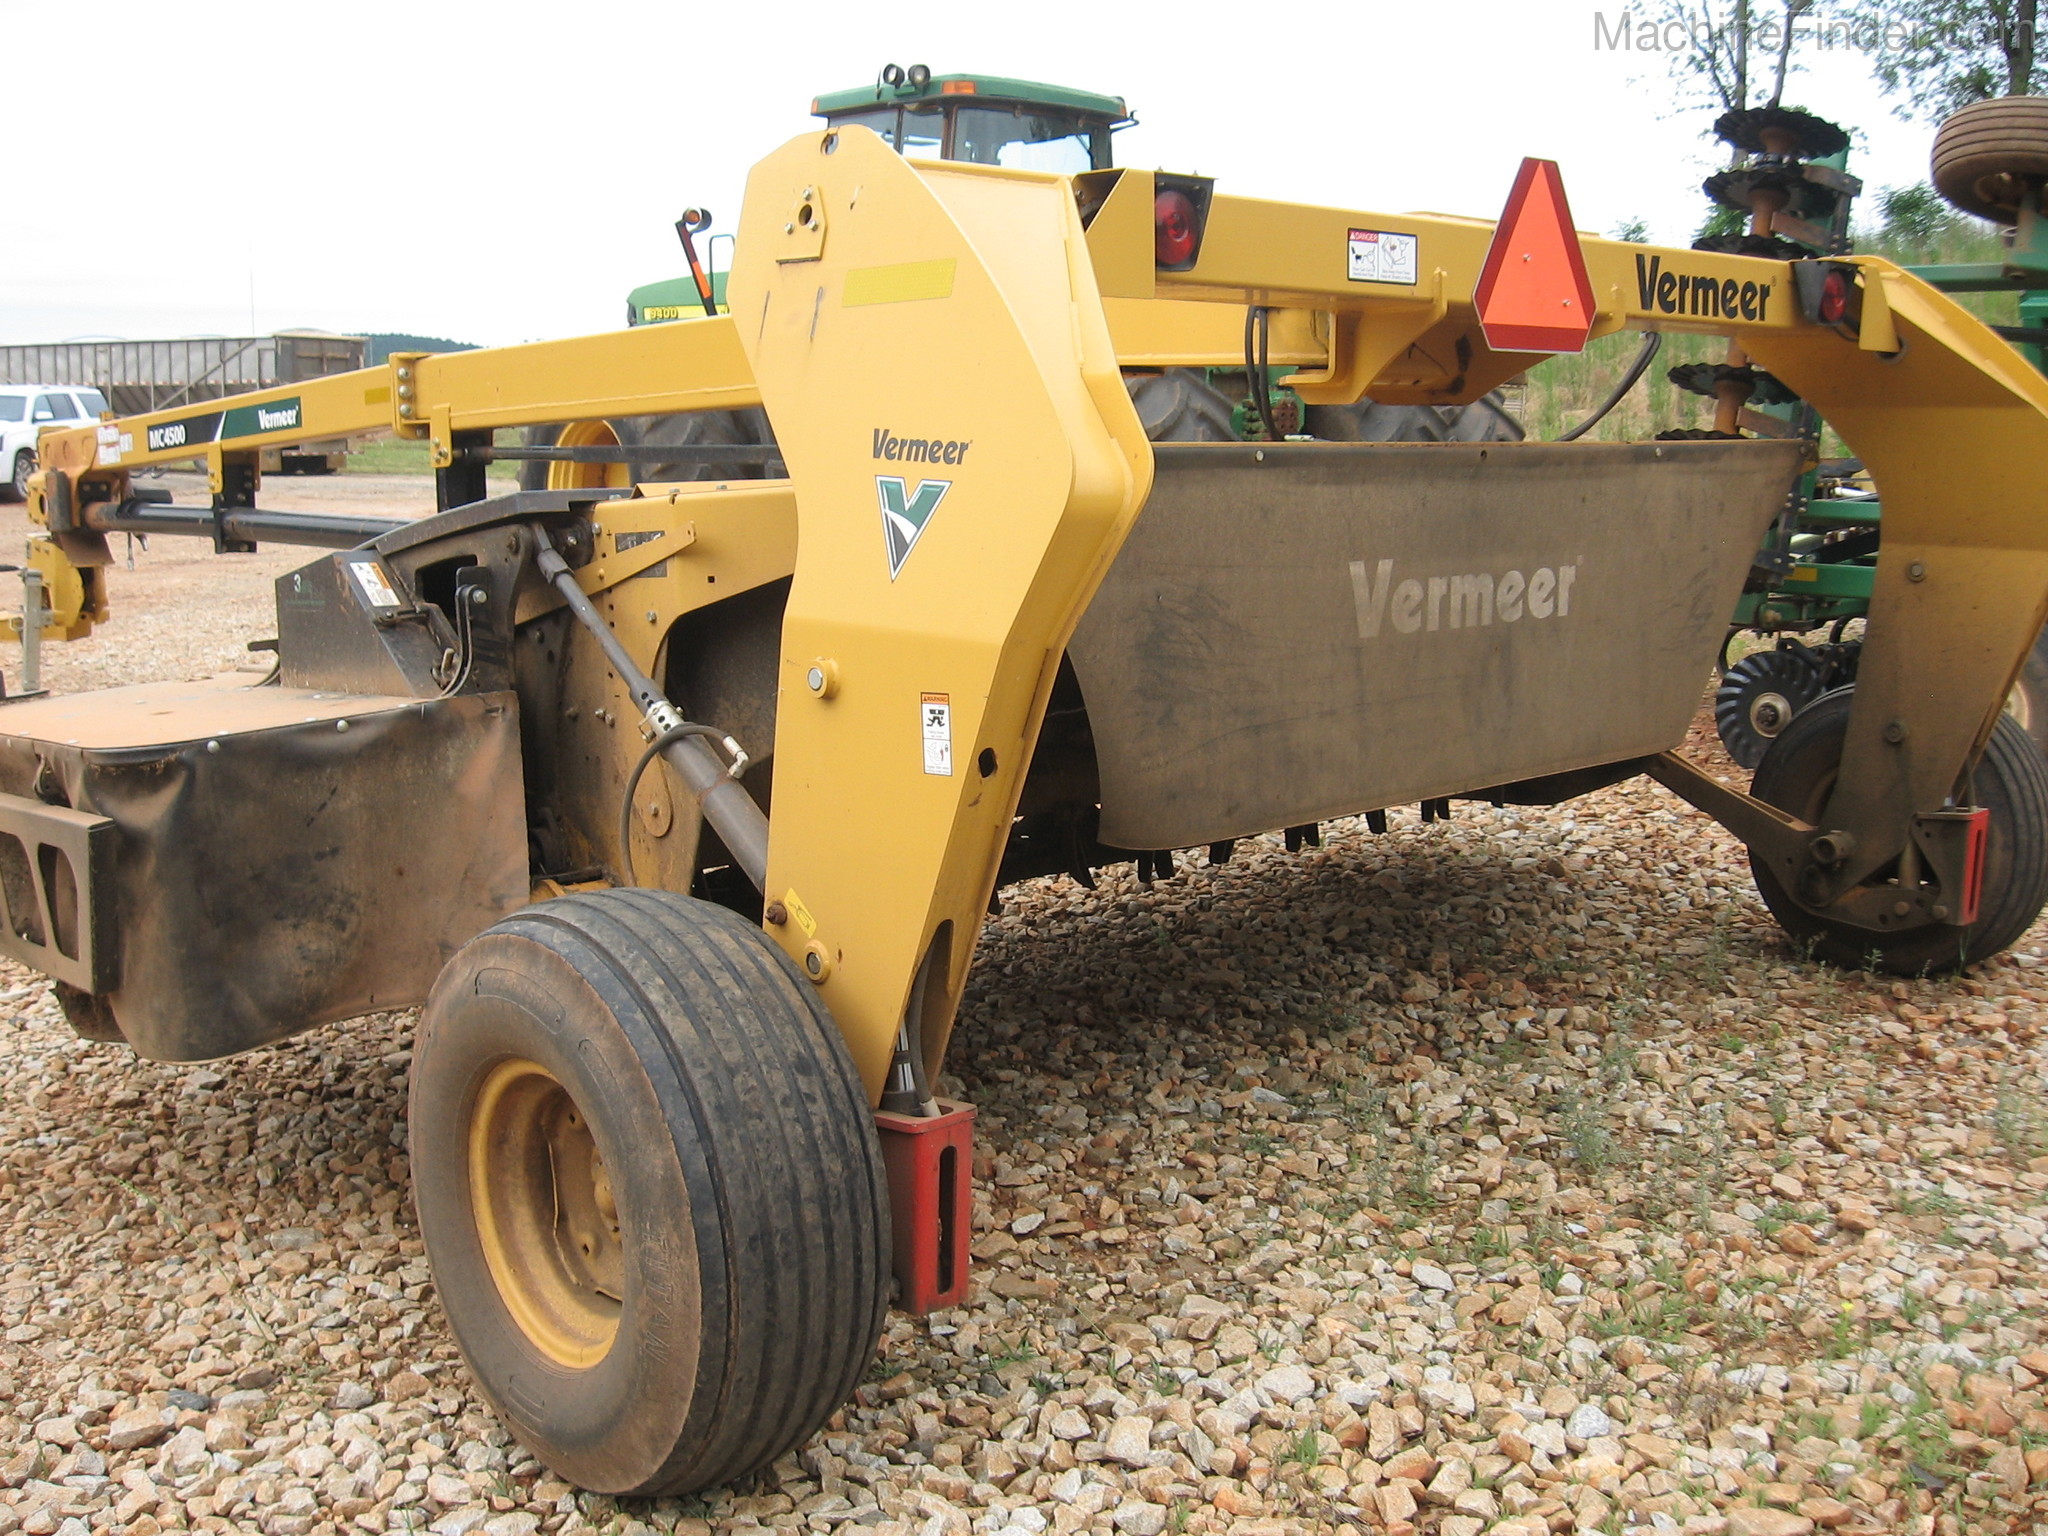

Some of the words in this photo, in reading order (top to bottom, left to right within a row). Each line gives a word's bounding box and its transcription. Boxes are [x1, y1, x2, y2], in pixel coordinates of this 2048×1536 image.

[1355, 232, 1378, 242] DANGER
[1635, 253, 1770, 321] Vermeer
[650, 306, 679, 319] 9400
[258, 407, 298, 430] Vermeer
[149, 424, 186, 449] MC4500
[873, 428, 969, 465] Vermeer
[1349, 558, 1577, 638] Vermeer
